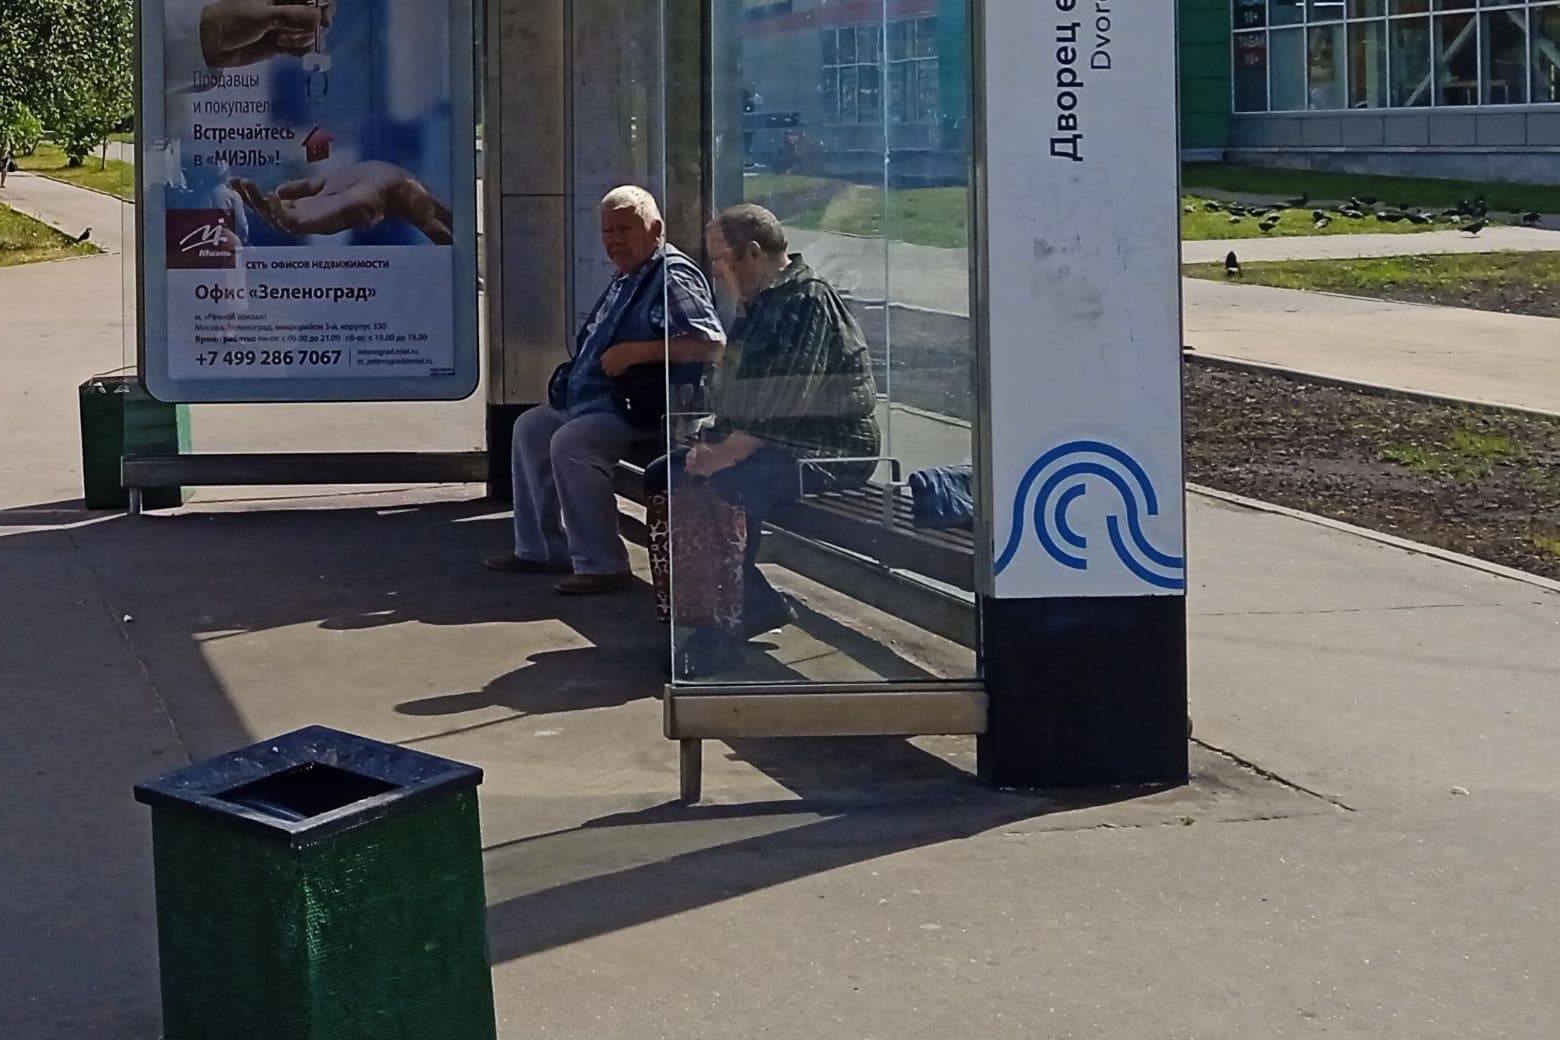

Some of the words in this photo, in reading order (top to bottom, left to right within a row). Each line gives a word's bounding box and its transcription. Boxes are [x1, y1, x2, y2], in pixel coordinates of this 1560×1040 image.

[192, 70, 259, 91] Продавцы
[1050, 22, 1084, 162] Дворец
[193, 101, 201, 113] и
[204, 100, 271, 118] покупател
[193, 123, 296, 144] Встречайтесь
[194, 154, 202, 167] в
[206, 149, 281, 167] «МИЭЛЬ»!
[245, 260, 268, 269] СЕТЬ
[271, 260, 310, 269] ОФИСОВ
[311, 259, 390, 270] НЕДВИЖИМОСТИ
[195, 283, 245, 303] Офис
[249, 283, 377, 303] «Зеленоград»
[195, 350, 218, 366] +7
[222, 350, 256, 366] 499
[260, 350, 294, 366] 286
[298, 349, 342, 366] 7067
